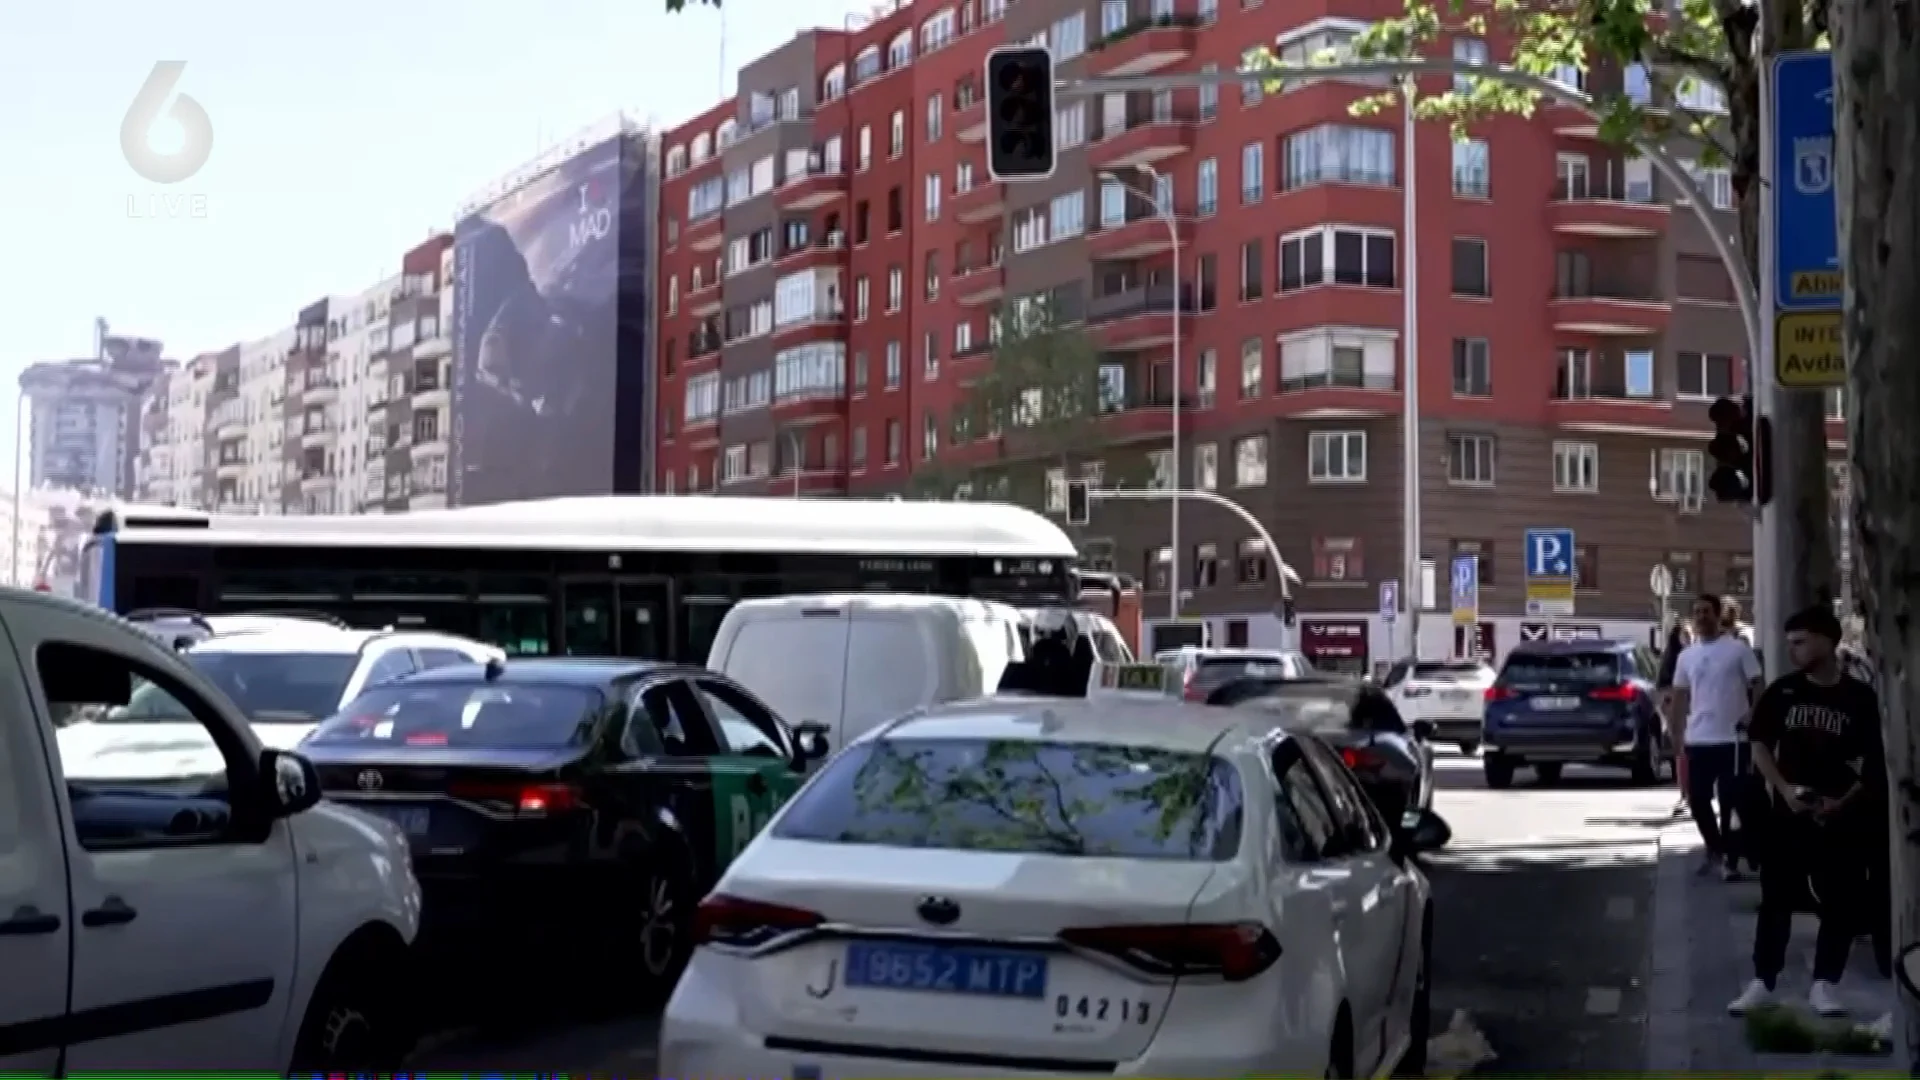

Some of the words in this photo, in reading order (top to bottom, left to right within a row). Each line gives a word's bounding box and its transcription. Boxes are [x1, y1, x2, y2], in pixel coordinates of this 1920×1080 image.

[569, 207, 611, 248] MAD
[1533, 534, 1561, 574] P
[968, 957, 1038, 993] MTP
[1056, 995, 1151, 1025] 04213
